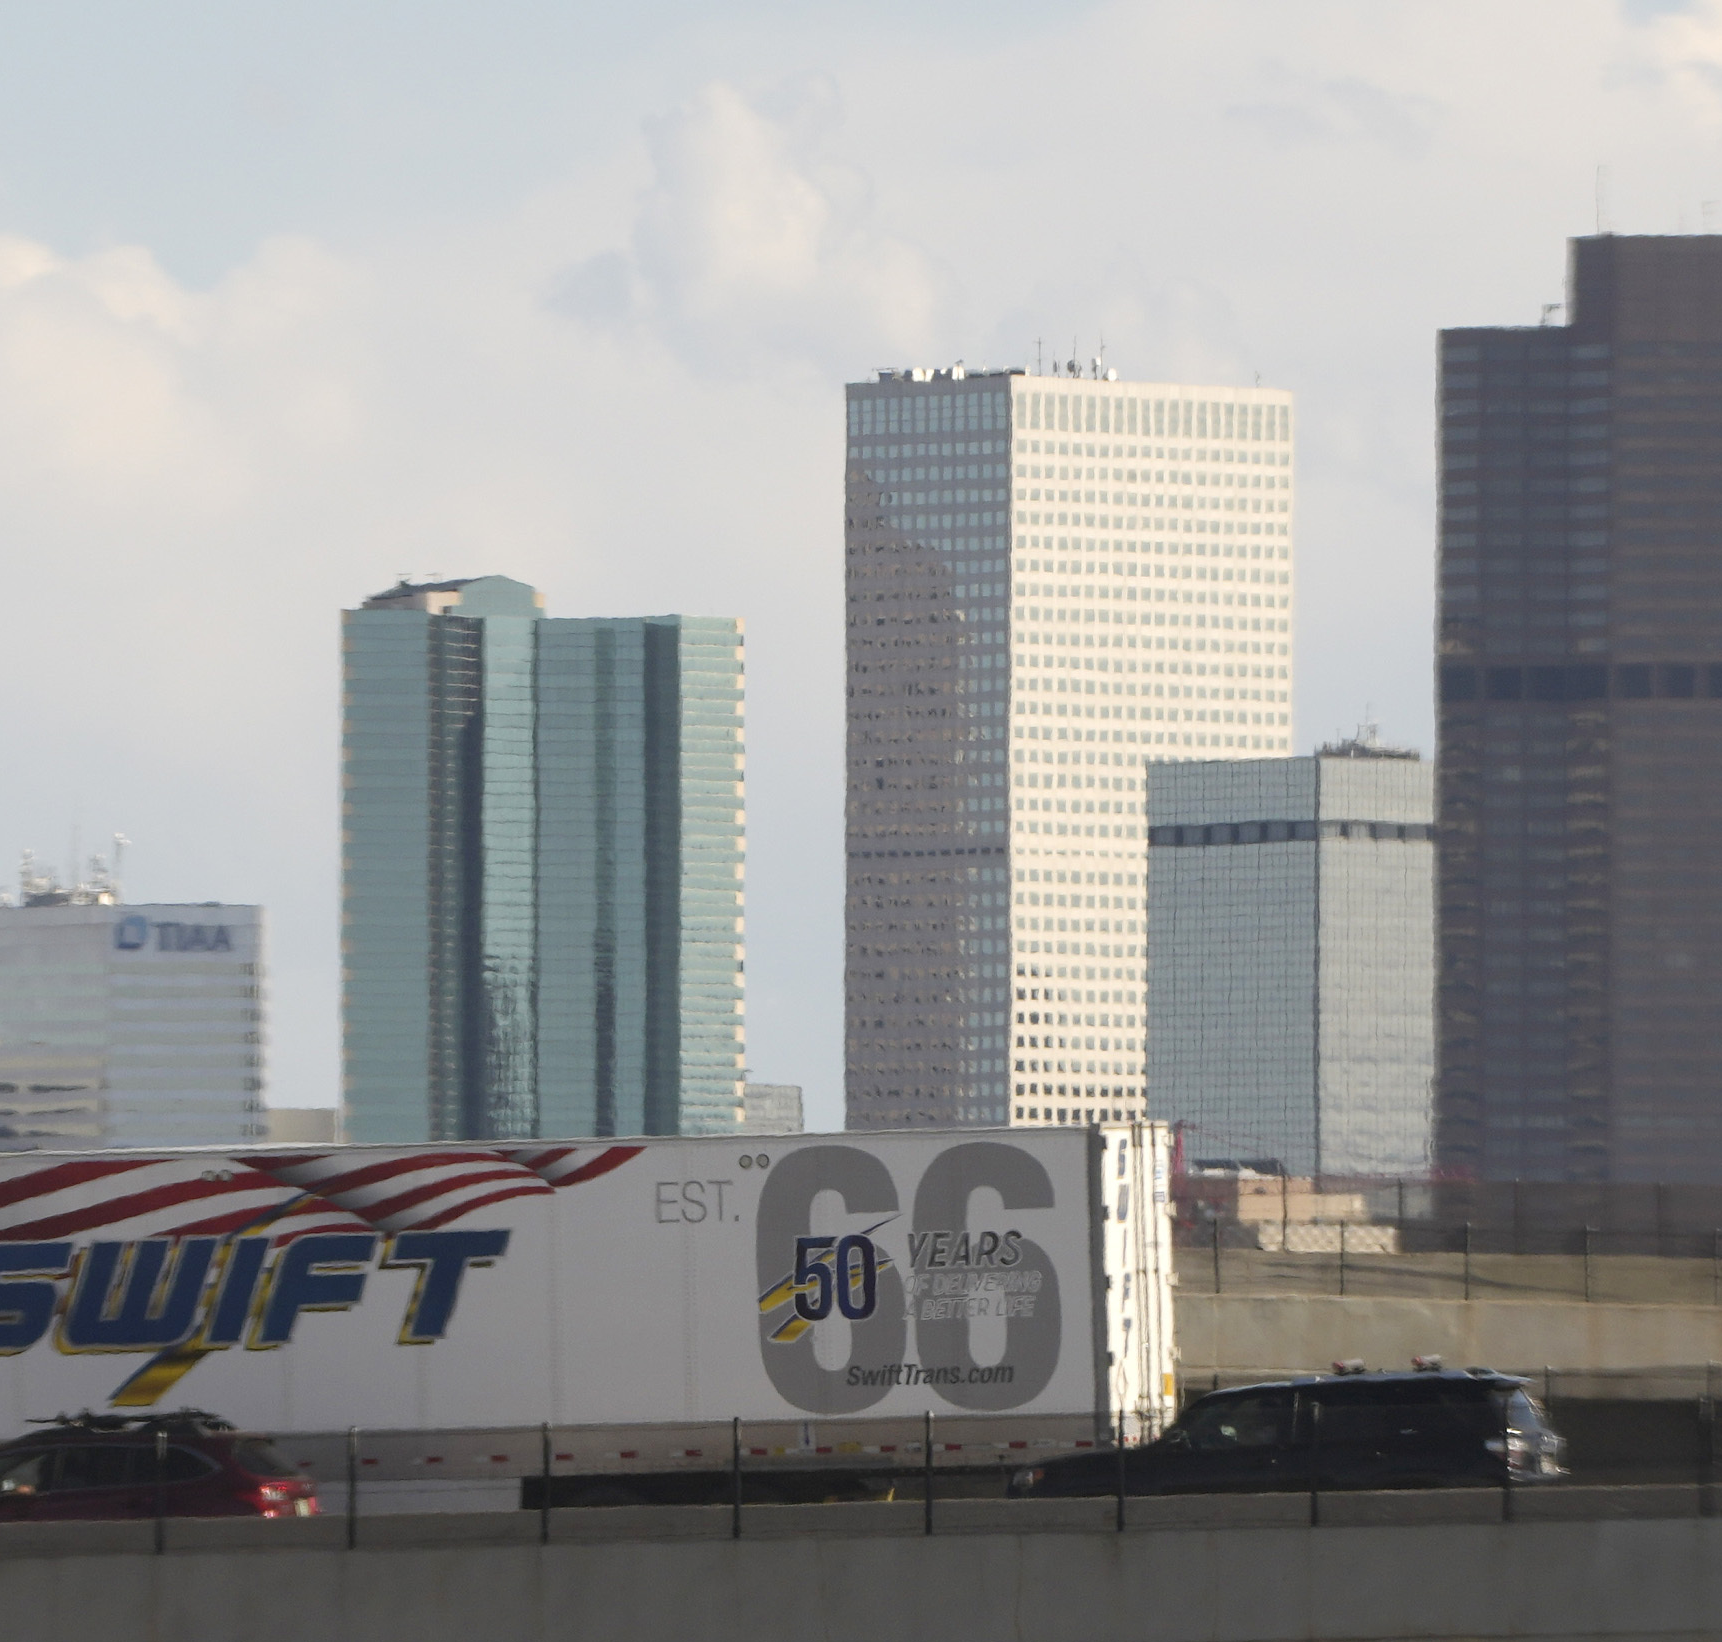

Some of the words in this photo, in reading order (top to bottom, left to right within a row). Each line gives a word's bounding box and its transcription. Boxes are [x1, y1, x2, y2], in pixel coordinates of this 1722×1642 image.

[655, 1181, 740, 1223] EST.
[755, 1141, 1063, 1416] 66
[793, 1234, 877, 1322] 50
[907, 1230, 1023, 1268] YEARS
[921, 1298, 990, 1321] BETTER
[995, 1296, 1037, 1318] LIFE
[845, 1364, 1015, 1387] SwiftTrans.com
